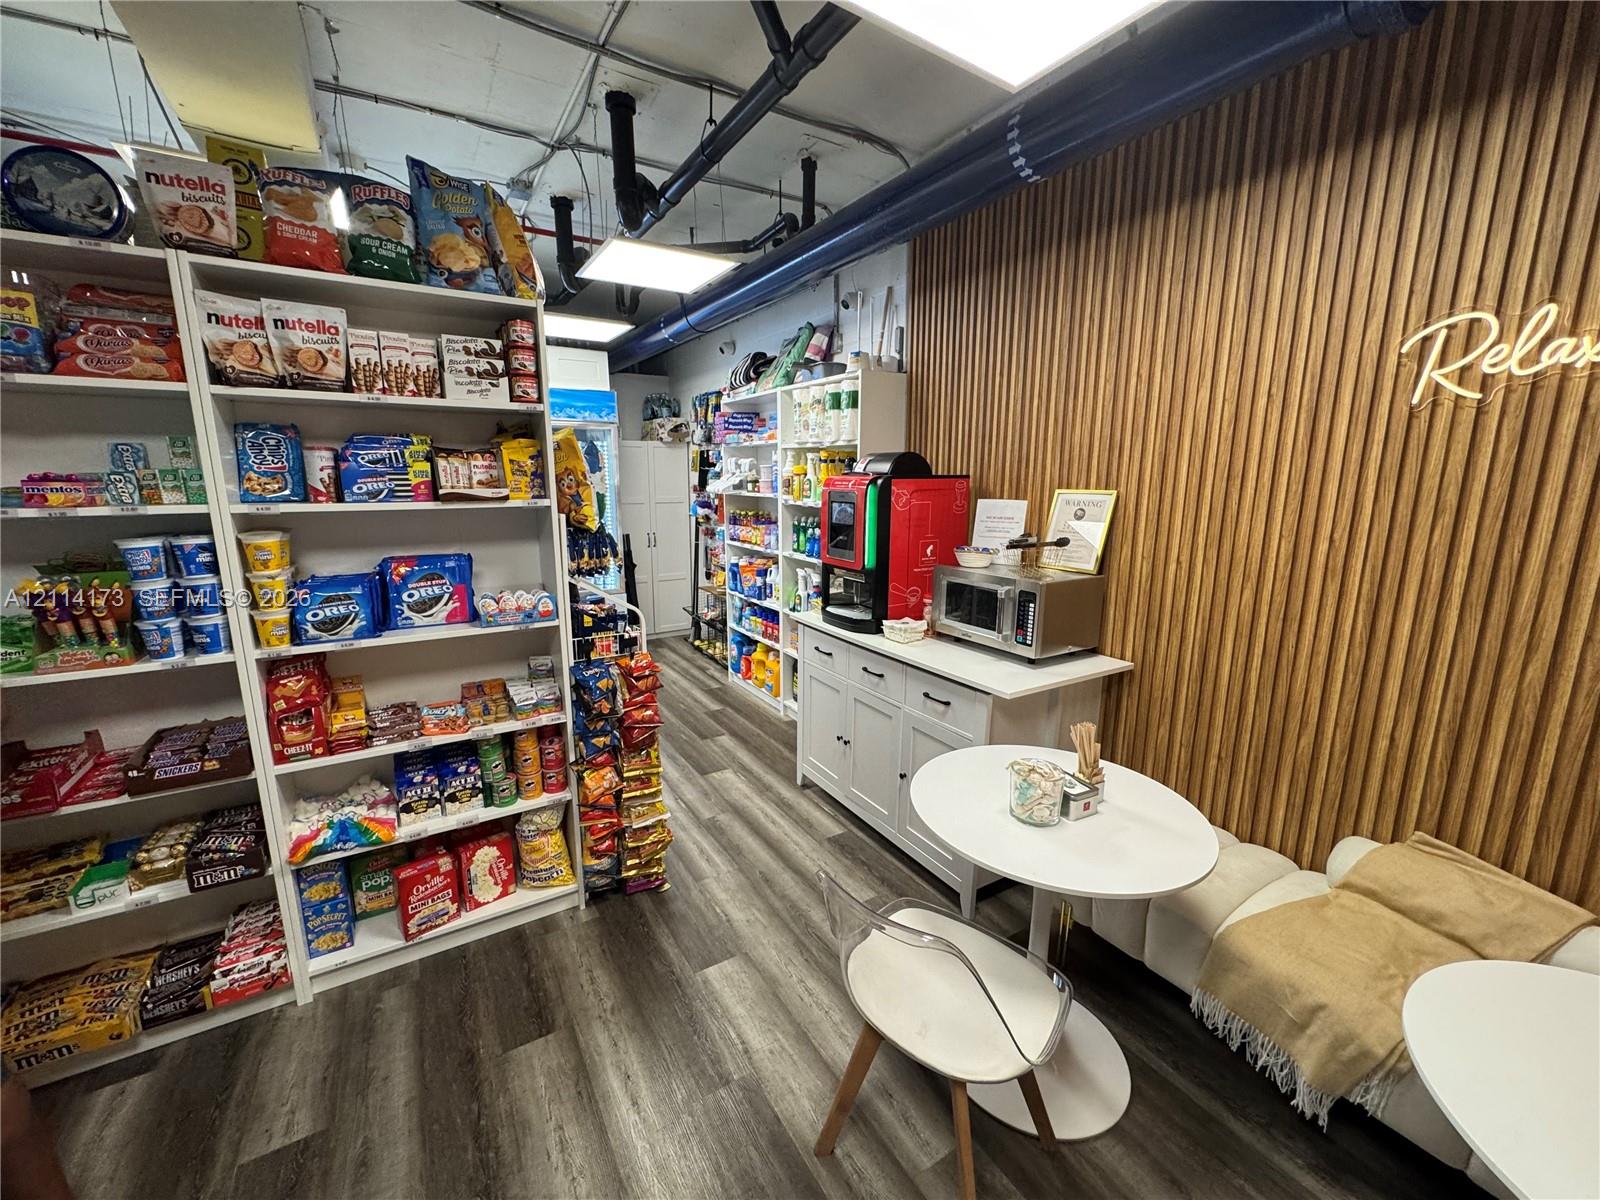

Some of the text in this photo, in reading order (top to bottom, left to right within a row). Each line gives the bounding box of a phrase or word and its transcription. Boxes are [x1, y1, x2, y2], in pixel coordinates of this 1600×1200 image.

[145, 171, 226, 193] nutella
[450, 181, 470, 192] WISE
[181, 192, 226, 205] biscuits
[351, 184, 410, 210] RUFFLES
[432, 192, 479, 208] Golden
[276, 221, 318, 239] CHEDDAR
[360, 237, 408, 255] SOUR CREAM
[378, 248, 397, 259] ONION
[207, 312, 265, 330] nutell
[273, 318, 340, 336] nutella
[238, 332, 267, 340] biscu
[302, 335, 340, 345] biscuits
[1400, 303, 1600, 405] Relax
[117, 445, 136, 471] Extra
[261, 436, 286, 466] Chips
[358, 453, 390, 461] OREO
[110, 474, 133, 503] Extra
[353, 481, 395, 493] OREO
[1065, 500, 1102, 508] WARNING
[407, 581, 431, 589] DOUBLE
[401, 585, 453, 602] OREO
[305, 604, 360, 622] OREO
[0, 650, 26, 658] dent
[284, 743, 313, 756] CHEEZ-IT
[156, 763, 200, 777] SNICKERS
[450, 779, 465, 787] ACT
[406, 788, 421, 797] ACT
[360, 869, 390, 880] smart
[522, 865, 556, 874] Premium
[413, 874, 445, 895] Orville
[410, 891, 452, 912] MINI BAGS
[154, 963, 200, 987] HERSHEY'S
